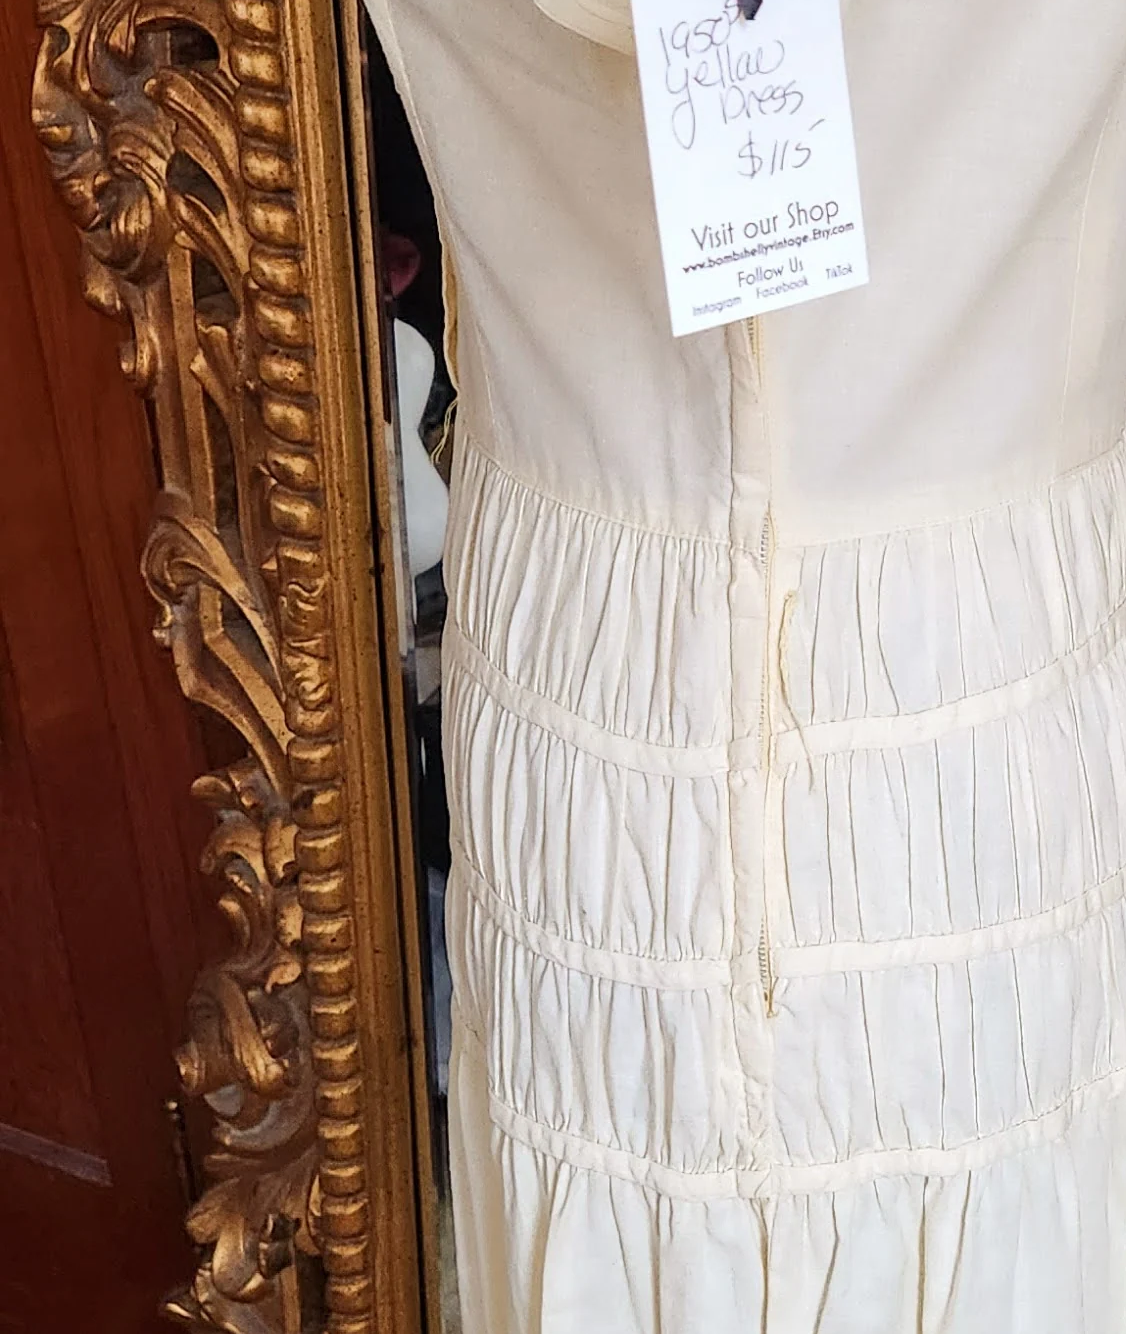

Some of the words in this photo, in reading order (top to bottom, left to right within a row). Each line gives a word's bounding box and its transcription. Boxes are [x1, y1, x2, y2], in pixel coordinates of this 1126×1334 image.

[691, 222, 734, 251] Visit
[743, 215, 778, 239] our
[787, 200, 839, 229] Shop
[692, 296, 742, 317] Instagram
[756, 275, 809, 299] Facebook
[825, 264, 853, 280] TikTok
[737, 265, 784, 288] Follow
[788, 256, 804, 273] Us
